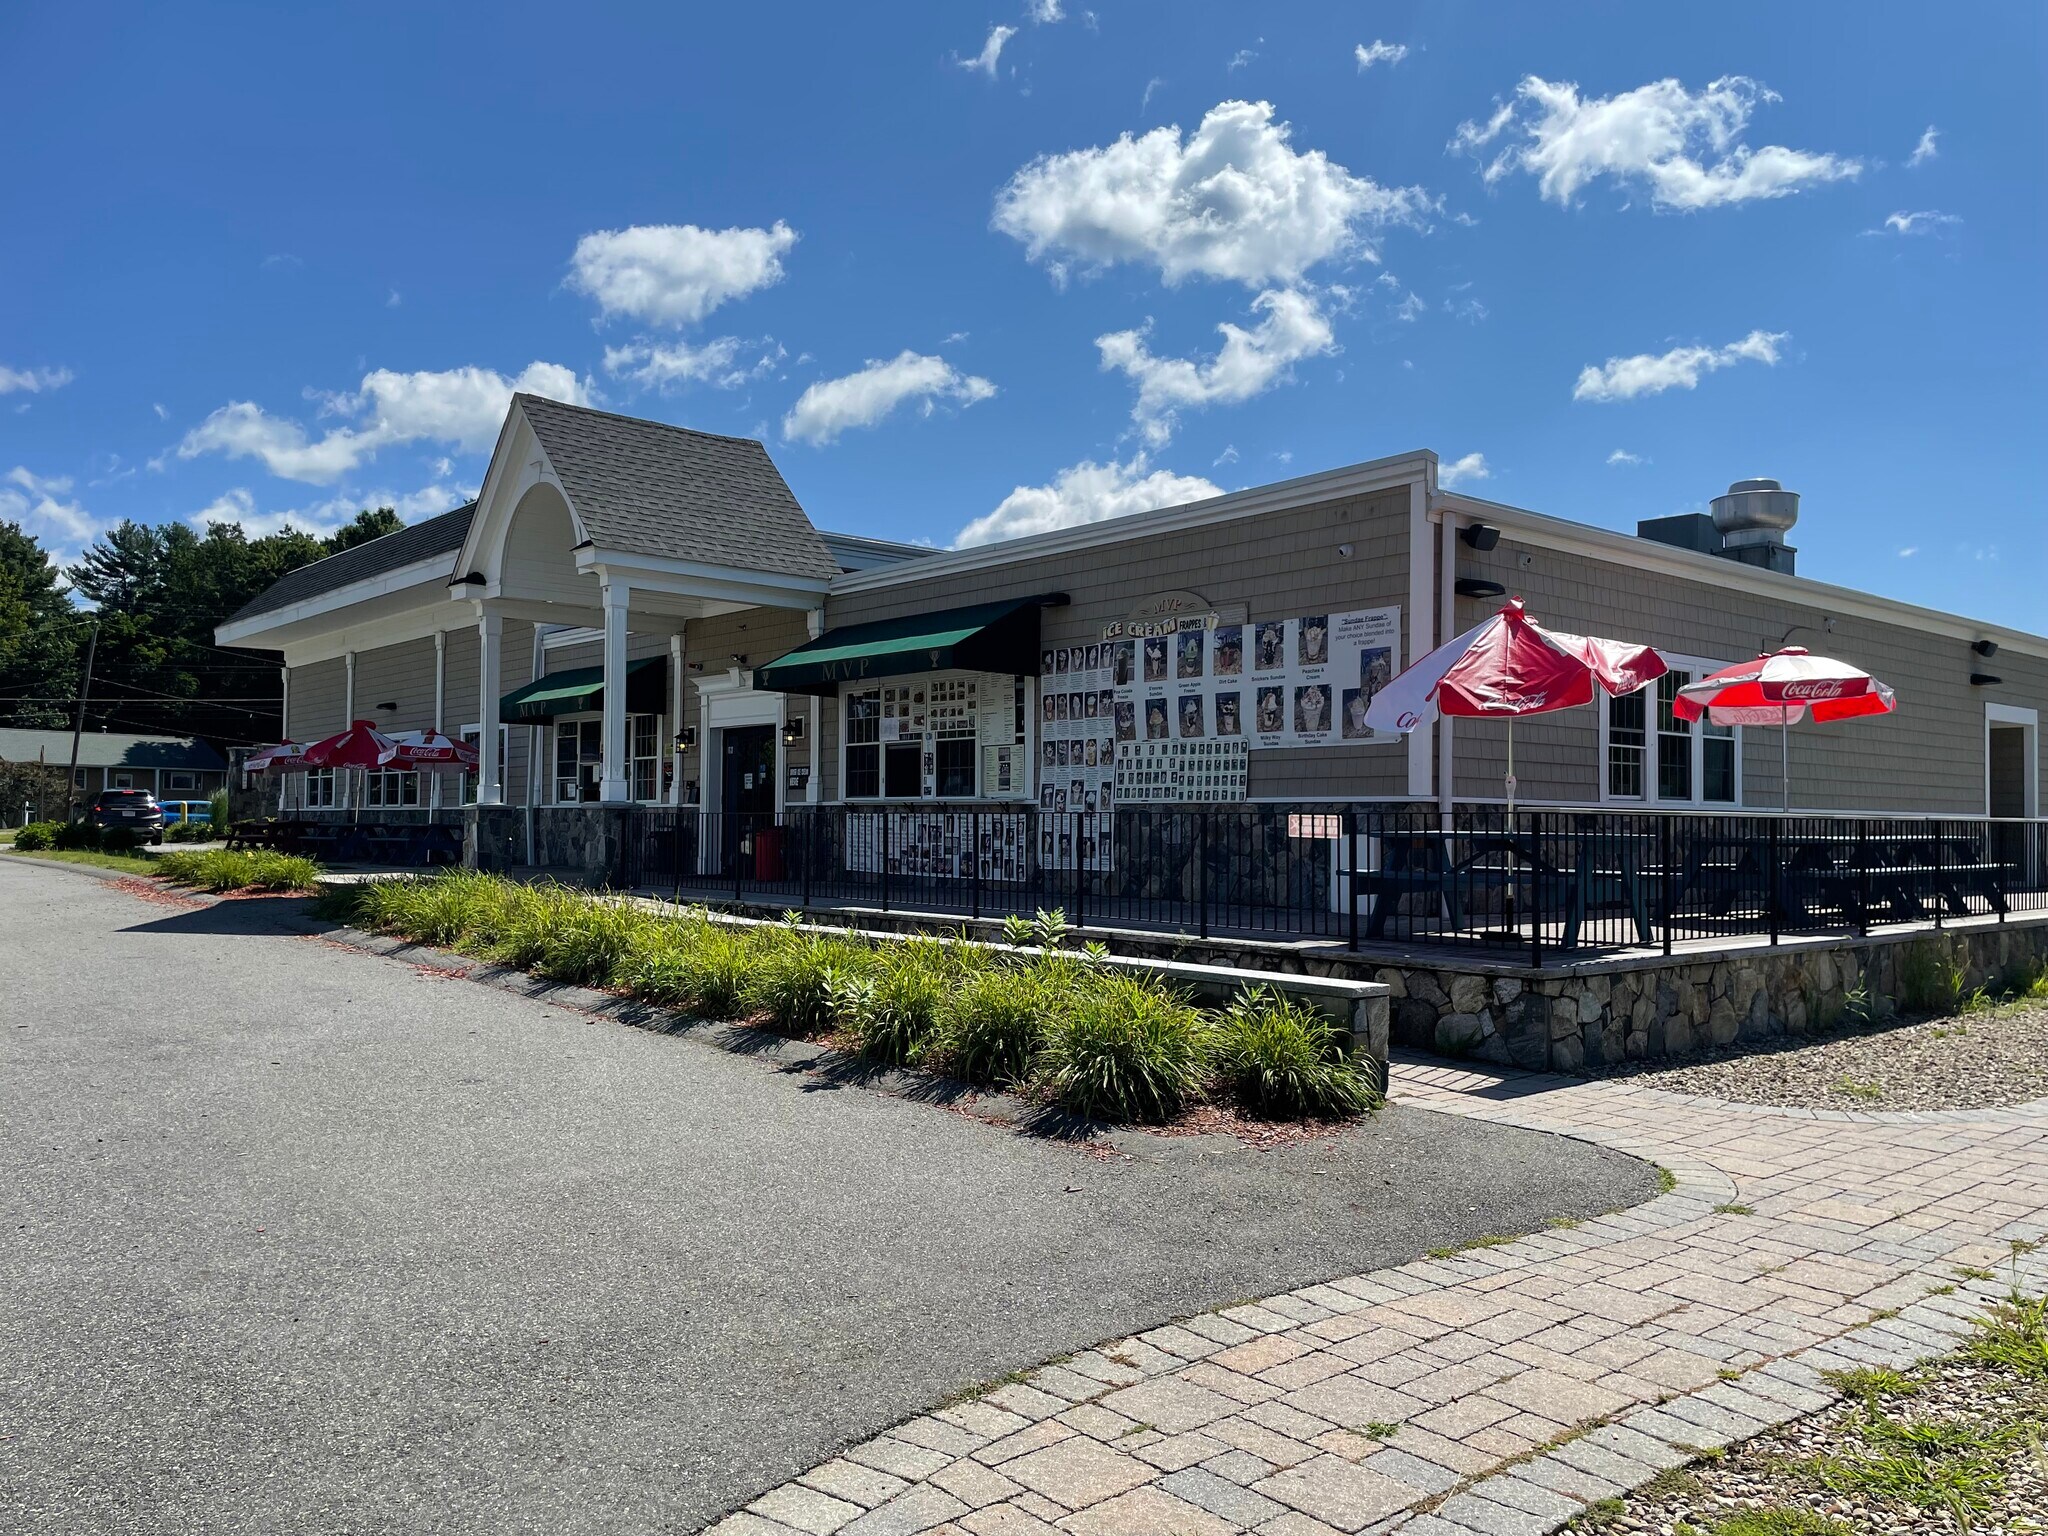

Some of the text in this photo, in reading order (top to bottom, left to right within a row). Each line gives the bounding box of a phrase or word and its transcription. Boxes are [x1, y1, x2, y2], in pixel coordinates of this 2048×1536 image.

[1153, 598, 1182, 614] MVP
[1102, 617, 1178, 639] ICE CREAM
[1179, 618, 1202, 631] FRAPPES
[822, 658, 869, 681] MVP
[520, 701, 546, 718] MVP
